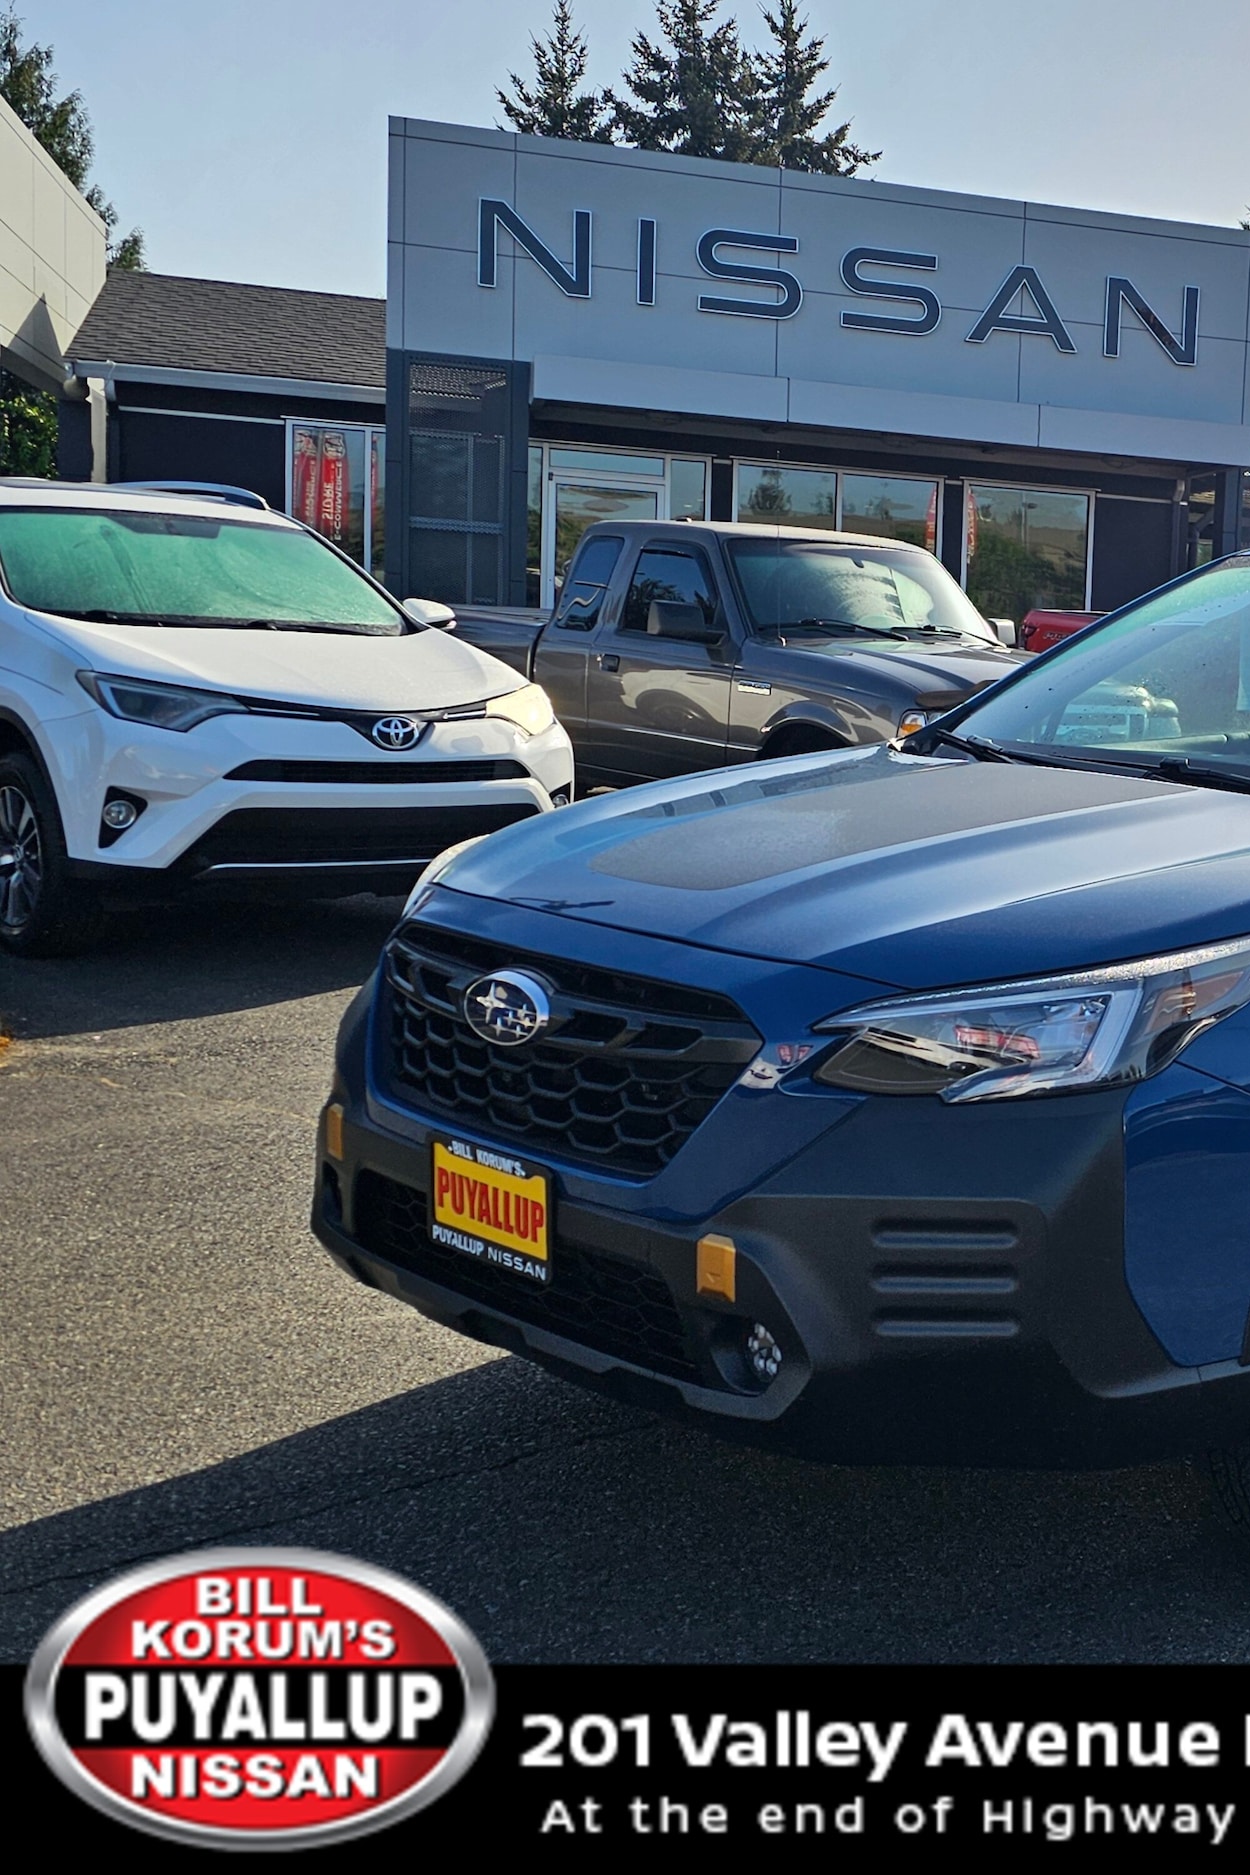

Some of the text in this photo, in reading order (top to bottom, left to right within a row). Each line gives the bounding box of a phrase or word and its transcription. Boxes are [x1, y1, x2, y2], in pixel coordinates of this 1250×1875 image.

[477, 196, 1202, 366] NISSAN
[451, 1140, 474, 1161] BILL
[437, 1166, 545, 1244] PUYALLUP
[432, 1224, 547, 1281] PUYALLUP NISSAN
